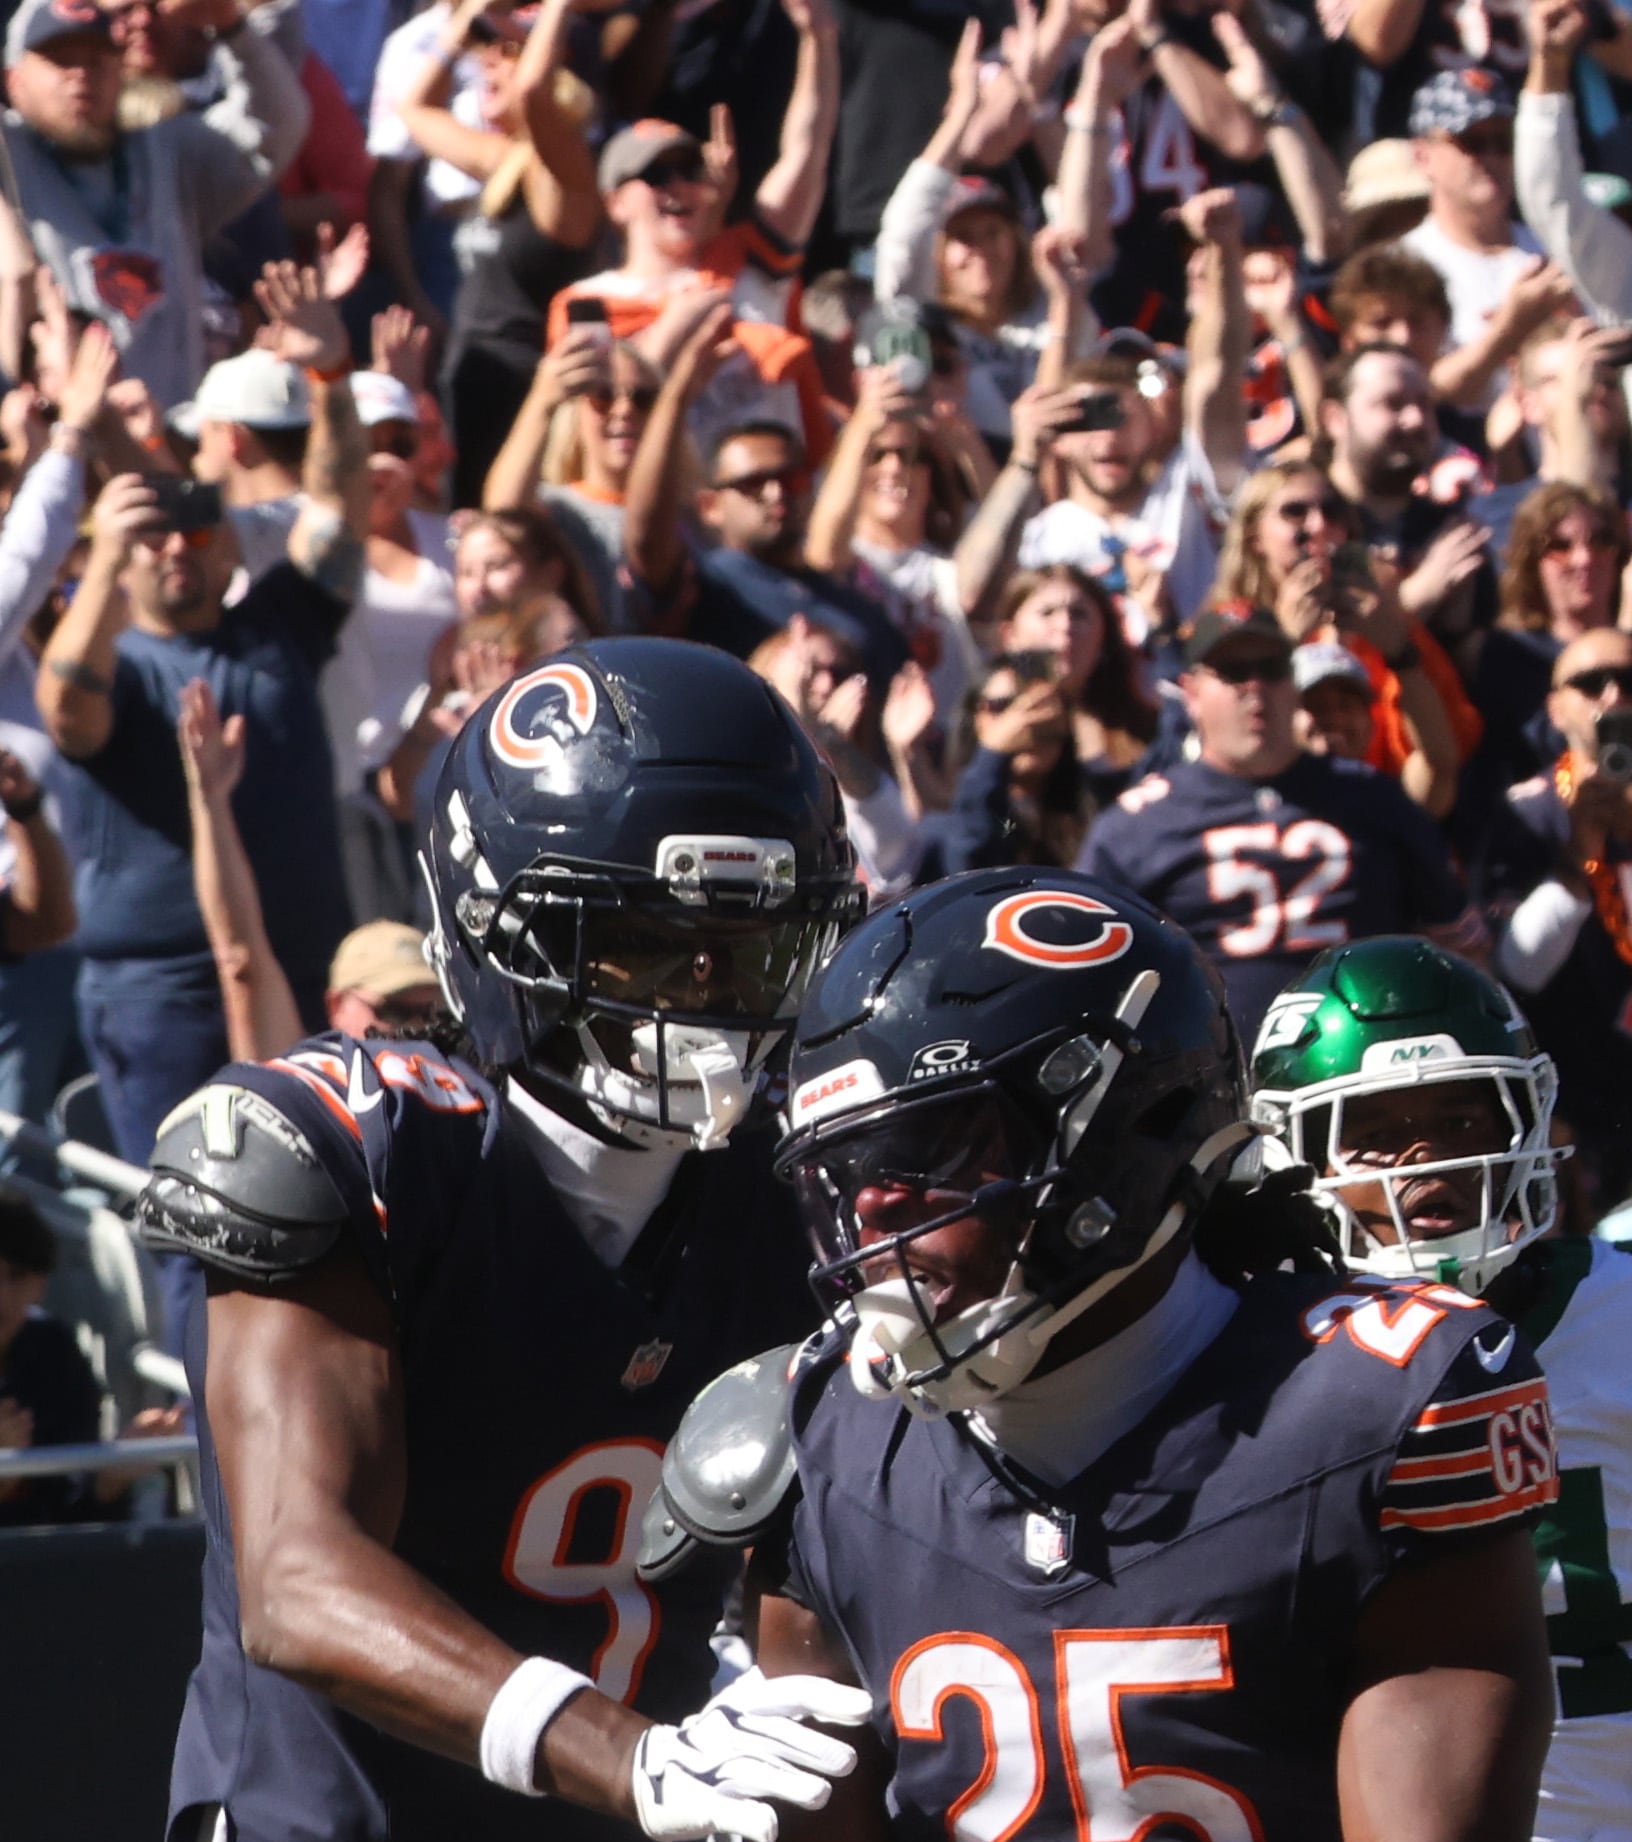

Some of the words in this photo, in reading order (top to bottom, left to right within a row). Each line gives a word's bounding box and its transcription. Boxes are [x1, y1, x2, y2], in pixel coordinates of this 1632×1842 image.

[489, 662, 598, 770] C
[1202, 818, 1353, 958] 52
[980, 890, 1134, 969] C
[913, 1059, 983, 1079] OAKLEY
[1390, 1044, 1436, 1063] NY
[800, 1073, 859, 1110] BEARS
